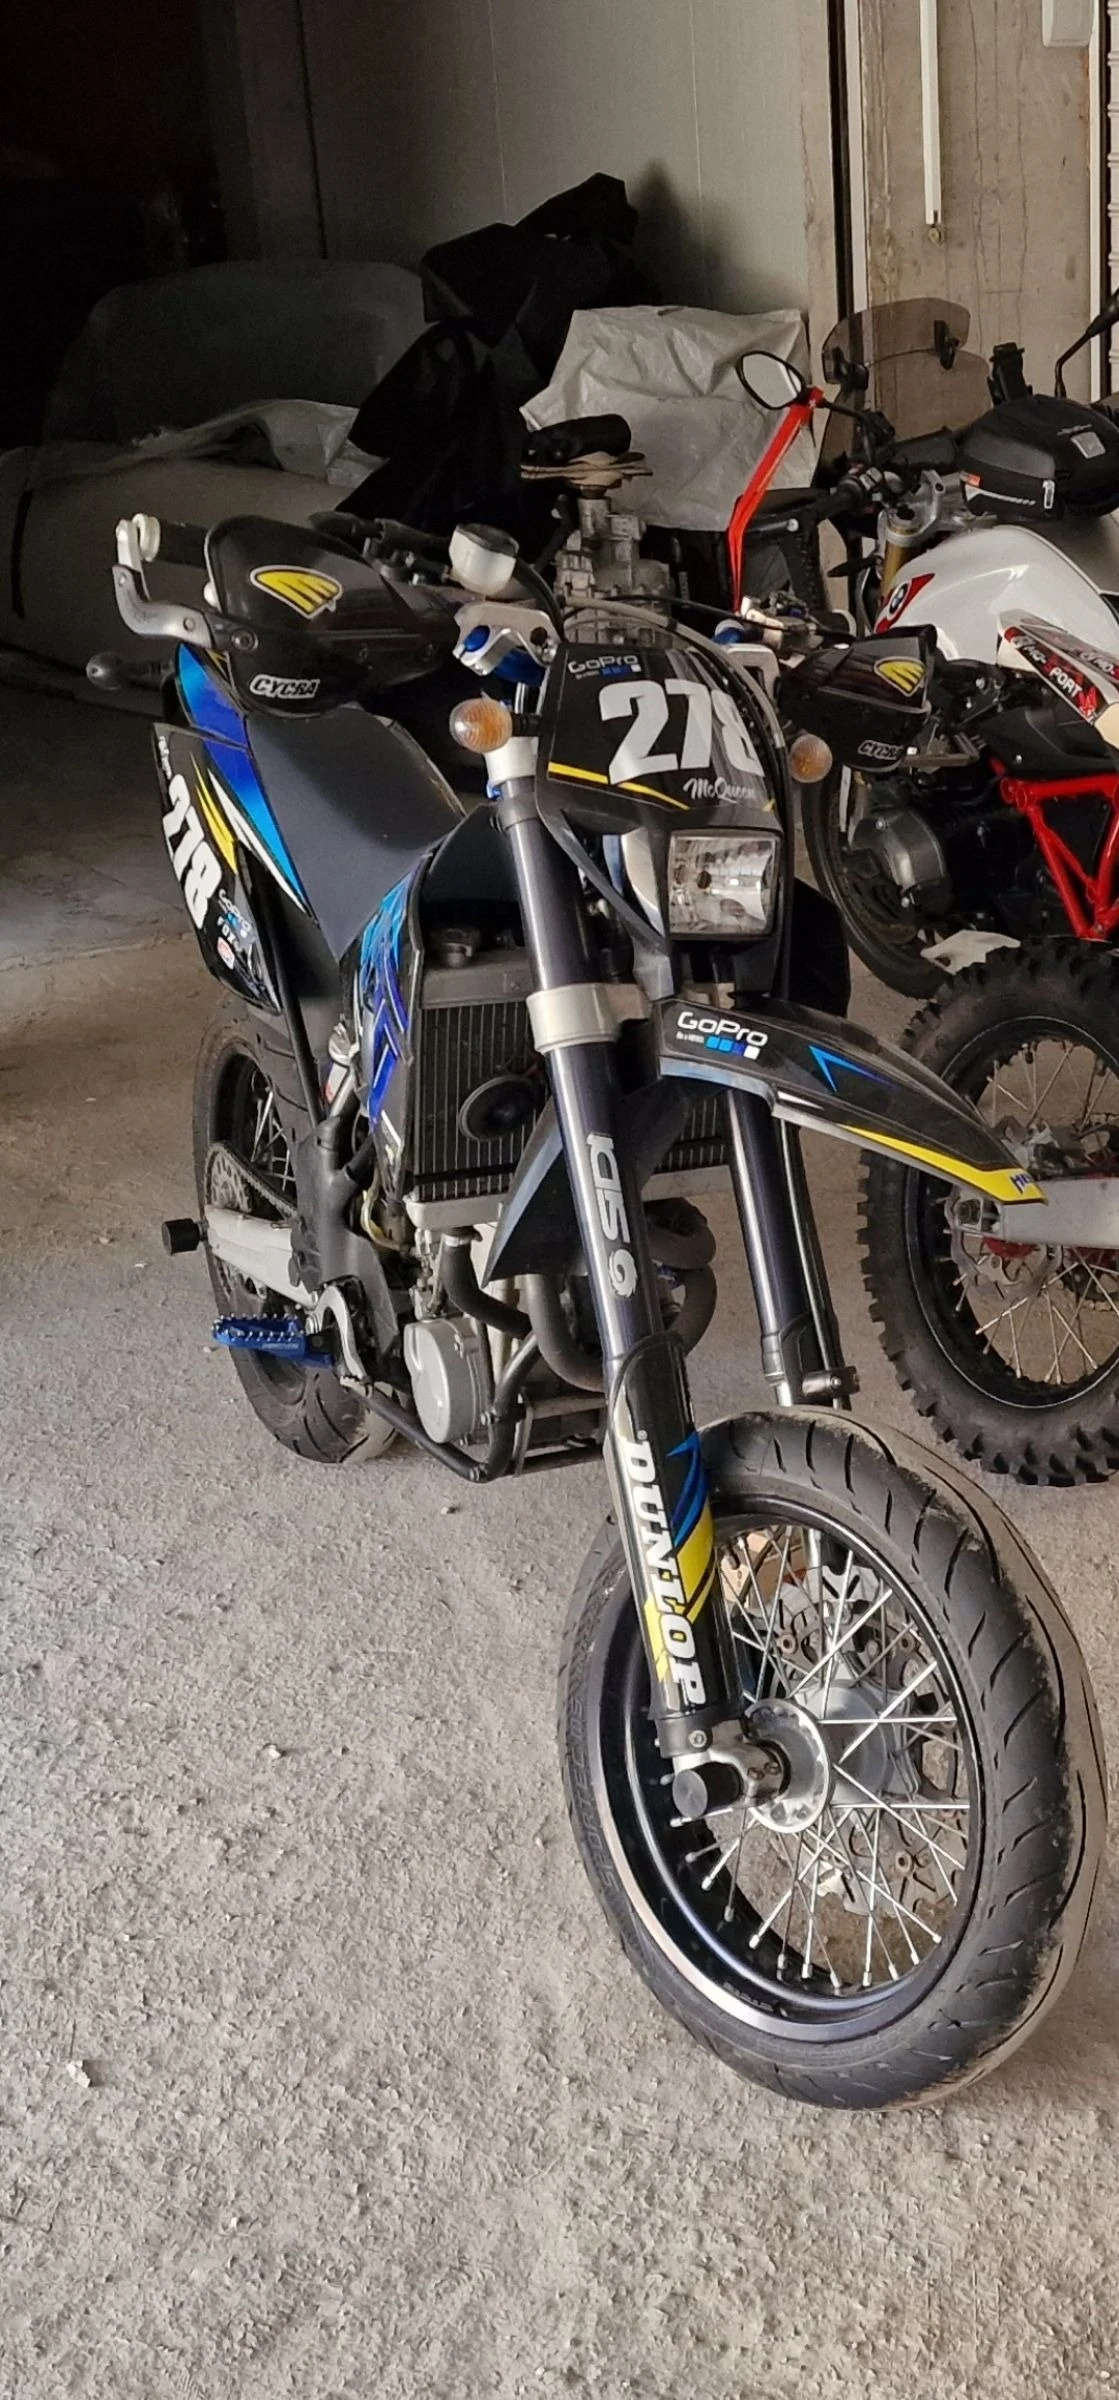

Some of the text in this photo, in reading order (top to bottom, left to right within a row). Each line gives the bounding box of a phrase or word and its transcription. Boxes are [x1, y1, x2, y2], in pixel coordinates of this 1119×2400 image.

[568, 655, 639, 674] GoPro
[599, 678, 766, 785] 278
[162, 774, 223, 929] 278
[677, 1011, 769, 1047] GoPro
[621, 1436, 707, 1707] DUNLOP
